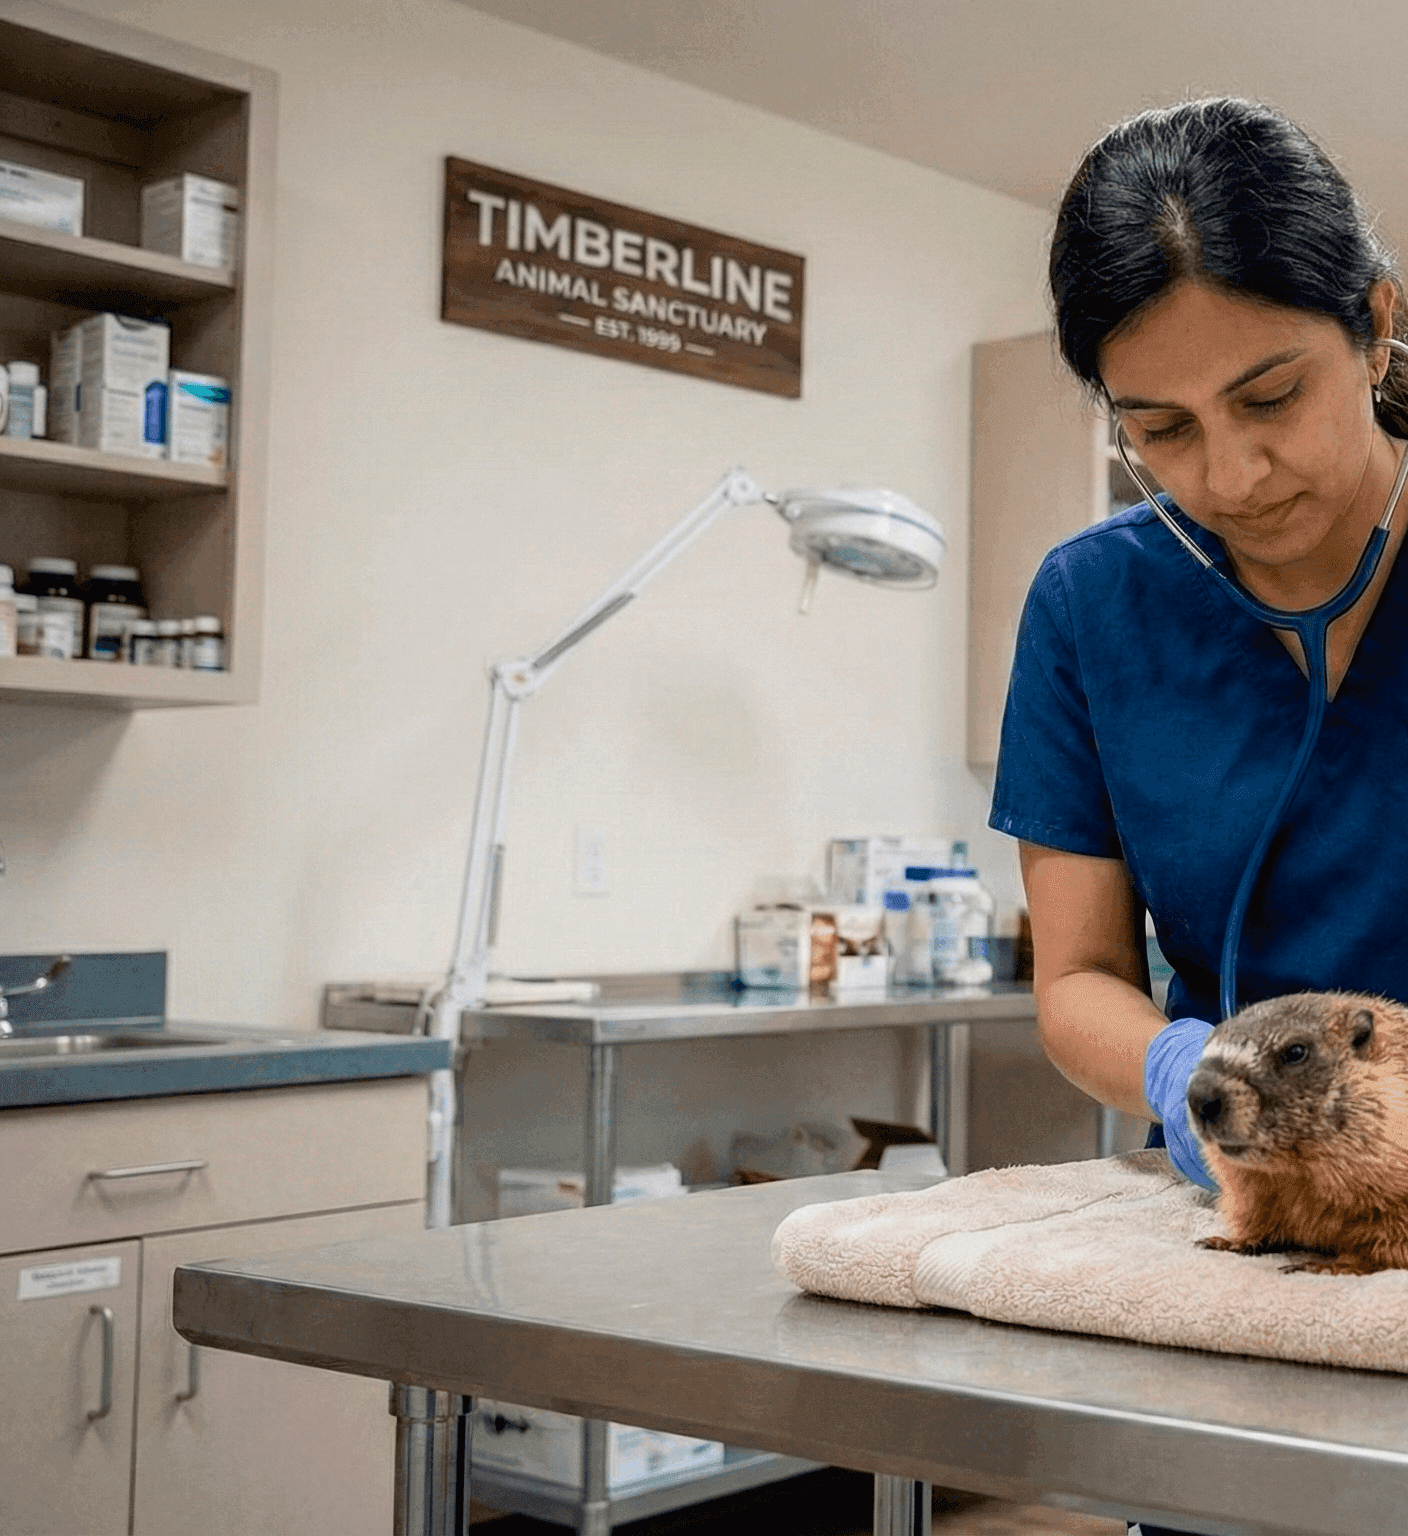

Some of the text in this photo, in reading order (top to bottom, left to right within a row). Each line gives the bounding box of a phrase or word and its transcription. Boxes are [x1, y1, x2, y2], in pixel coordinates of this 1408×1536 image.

[468, 190, 793, 322] TIMBERLINE
[495, 258, 767, 346] ANIMAL SANCTUARY
[595, 316, 682, 353] EST. 1999
